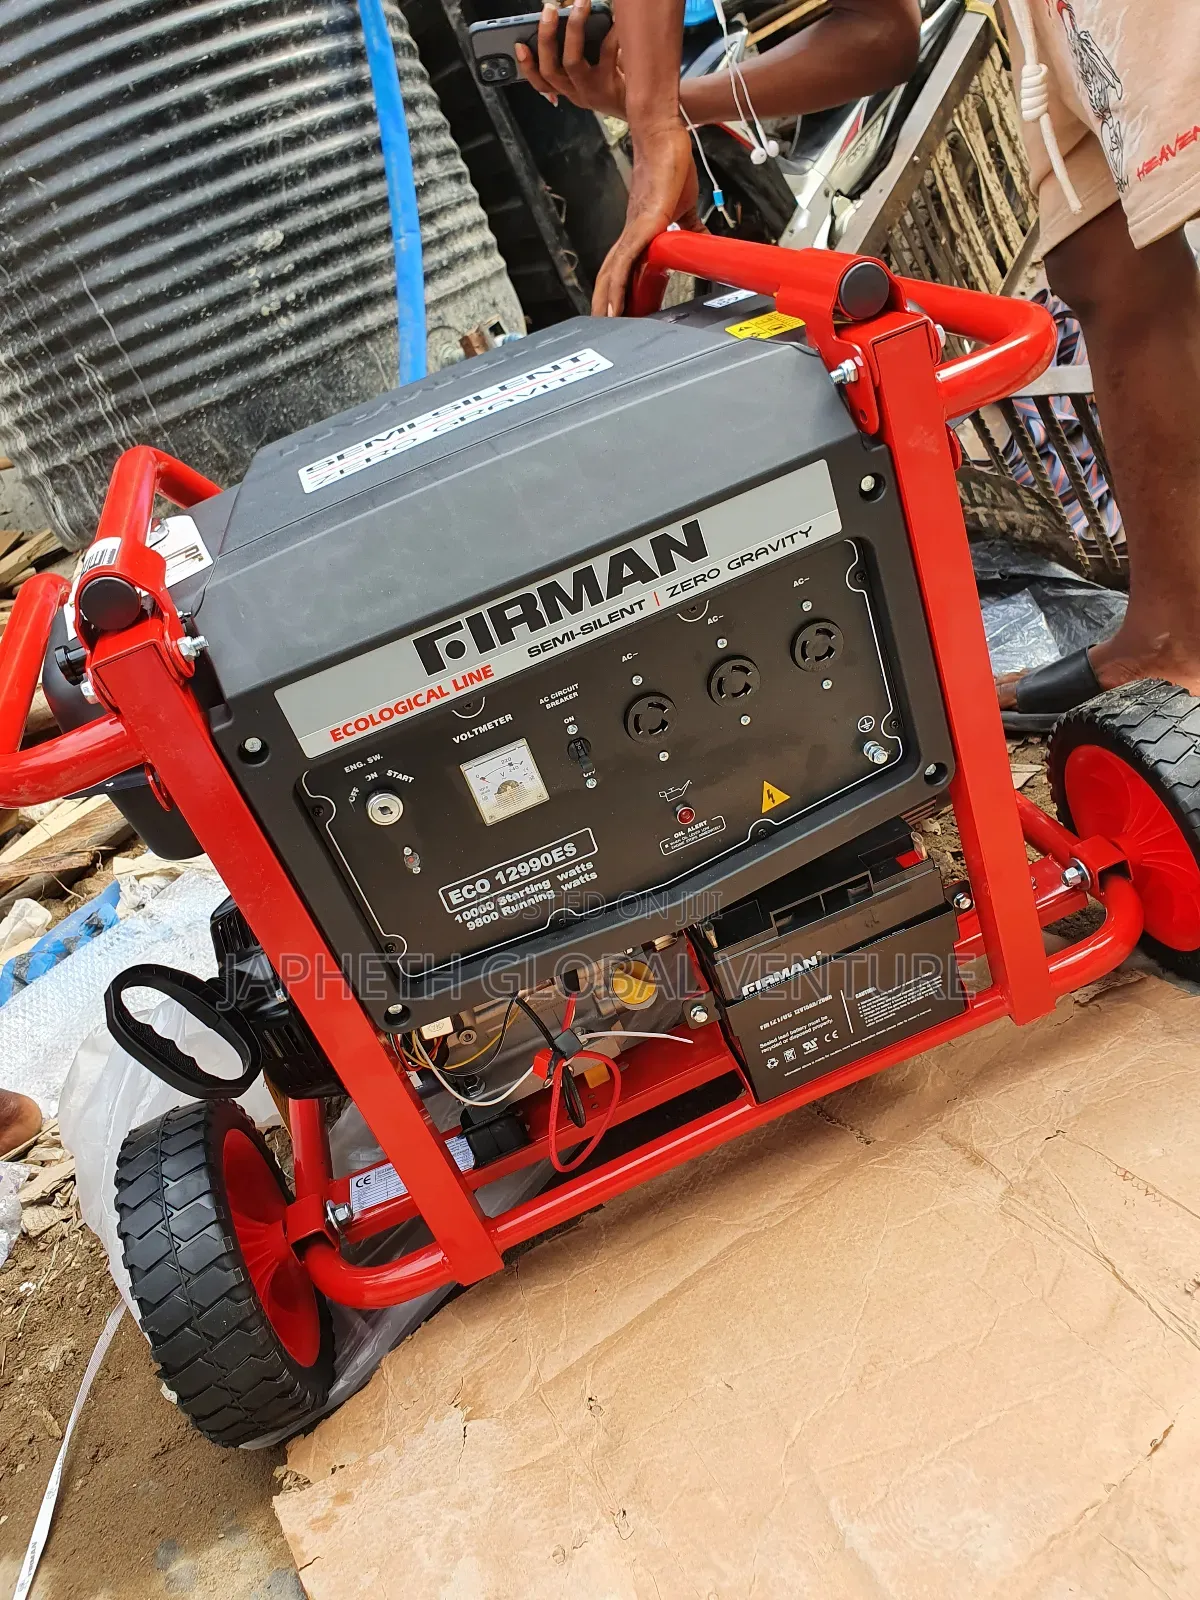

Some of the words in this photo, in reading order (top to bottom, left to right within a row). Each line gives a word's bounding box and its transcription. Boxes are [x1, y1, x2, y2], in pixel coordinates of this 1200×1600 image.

[306, 352, 587, 474] SEMI-SILENT
[311, 438, 418, 488] ZERO
[433, 363, 601, 433] GRAVITY
[412, 519, 709, 677] FIRMAN
[527, 599, 646, 658] SEMI-SILENT
[665, 568, 721, 598] ZERO
[727, 526, 813, 571] GRAVITY
[330, 684, 450, 742] ECOLOGICAL
[452, 664, 495, 692] LINE
[539, 696, 549, 705] AC
[551, 683, 579, 700] CIRCUIT
[545, 692, 578, 710] BREAKER
[452, 713, 513, 744] VOLTMETER
[563, 715, 575, 724] ON
[344, 761, 366, 773] ENG.
[367, 753, 383, 764] SW.
[386, 769, 415, 783] START
[348, 786, 360, 803] OFF
[673, 831, 685, 839] OIL
[687, 820, 707, 833] ALERT
[448, 878, 490, 905] ECO
[495, 842, 577, 885] 12990ES
[454, 901, 495, 924] 10000
[498, 879, 551, 906] Starting
[557, 861, 594, 882] watts
[466, 911, 499, 931] 9800
[501, 889, 556, 917] Running
[561, 871, 598, 892] watts
[742, 955, 818, 996] FIRMAN
